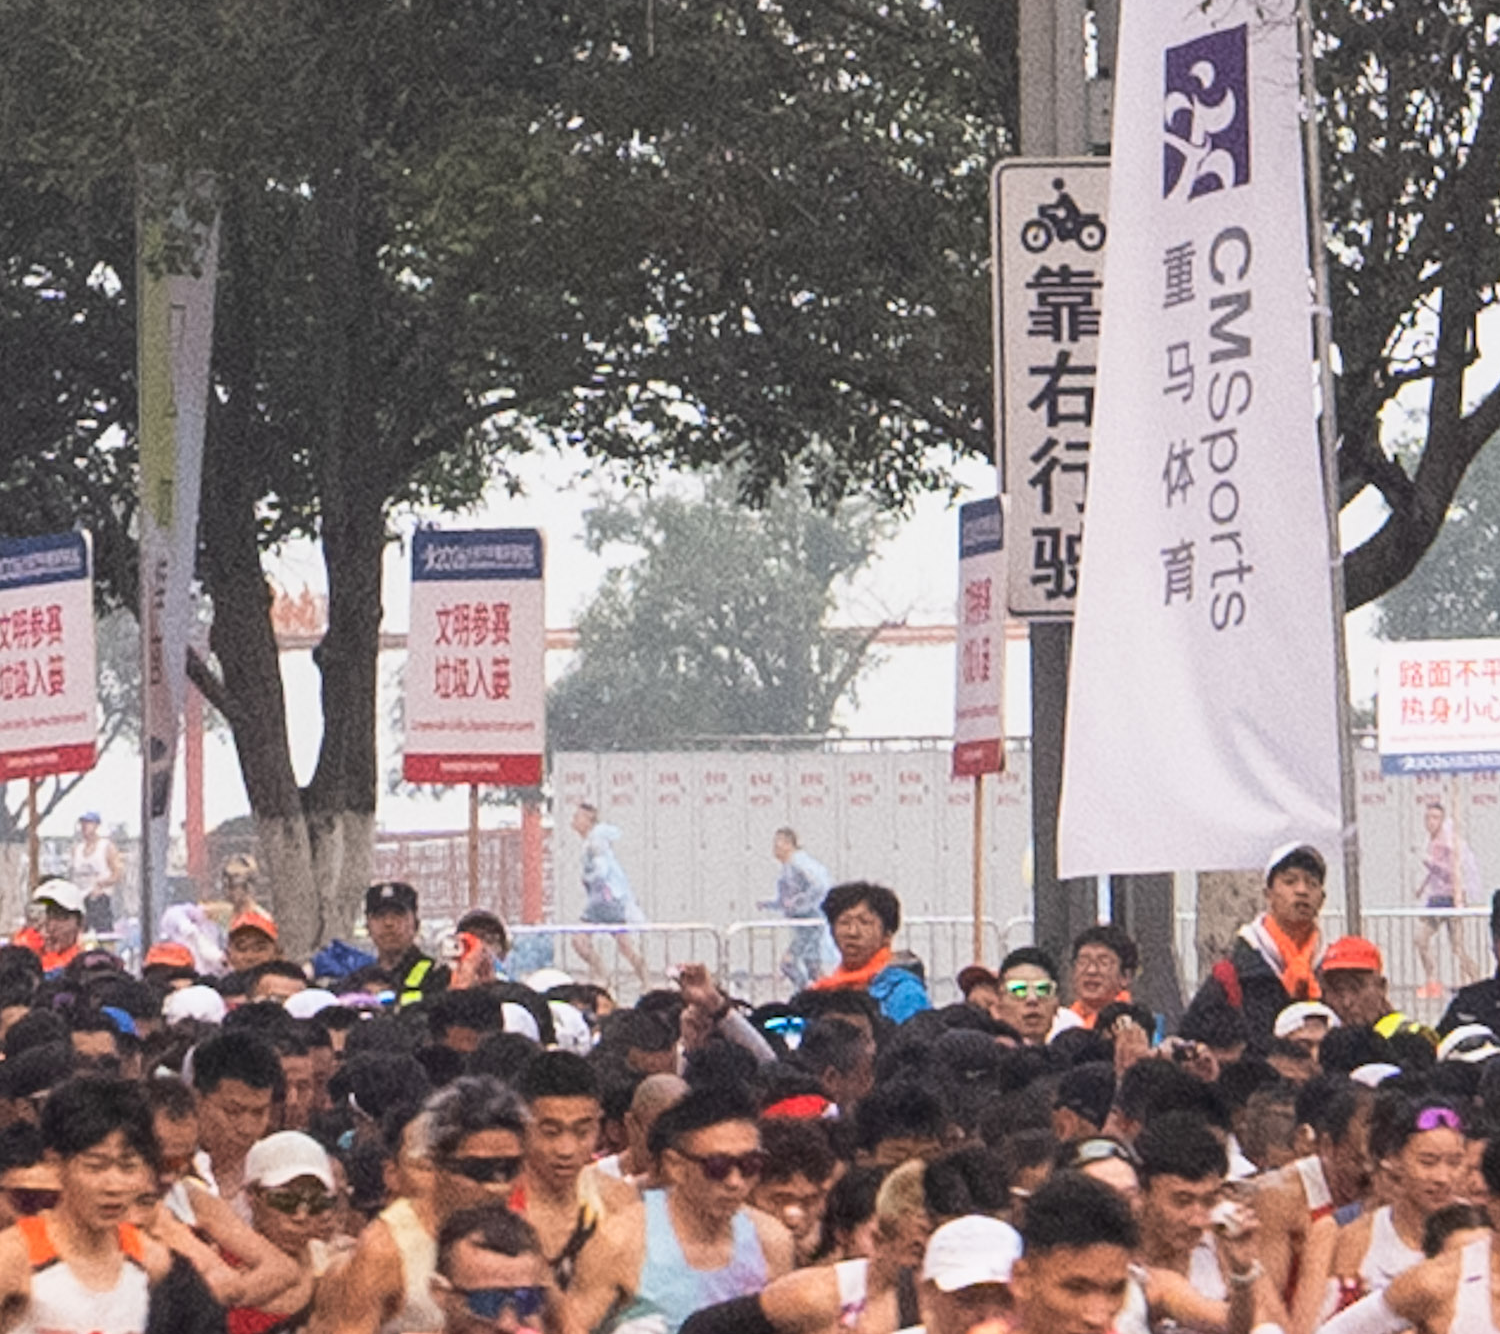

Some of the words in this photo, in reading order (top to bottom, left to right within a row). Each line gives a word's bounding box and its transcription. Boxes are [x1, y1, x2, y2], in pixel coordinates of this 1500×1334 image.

[1025, 264, 1104, 602] 靠右行驶
[1160, 240, 1198, 607] 重马体育
[1200, 225, 1254, 632] CMSports
